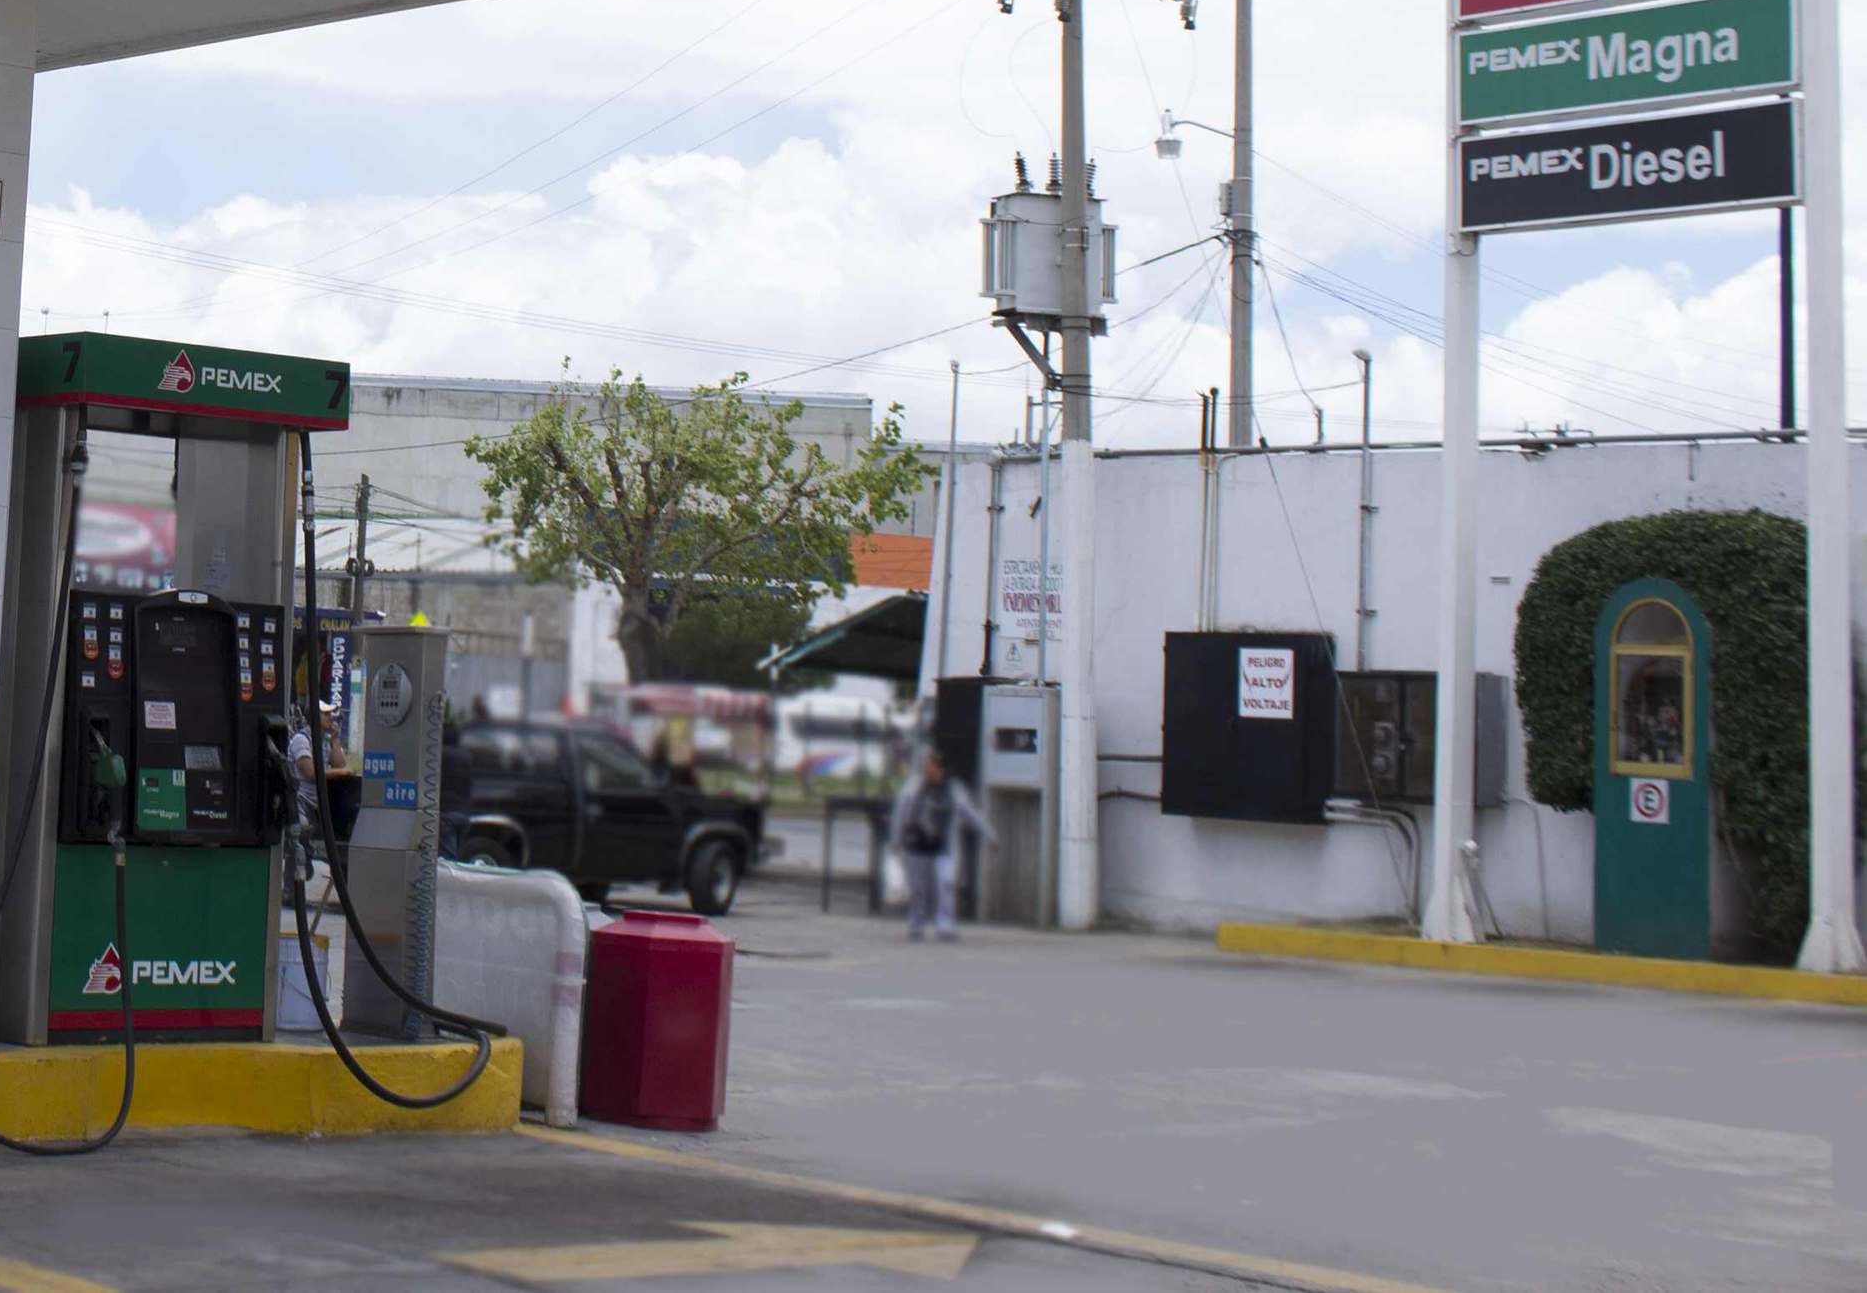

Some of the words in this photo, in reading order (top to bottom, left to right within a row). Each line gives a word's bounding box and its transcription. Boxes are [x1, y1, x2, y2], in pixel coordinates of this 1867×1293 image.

[1468, 38, 1581, 75] PEMEX
[1587, 27, 1739, 82] Magna
[1469, 147, 1584, 183] PEMEX
[1589, 130, 1726, 190] Diesel
[62, 342, 82, 383] 7
[201, 367, 282, 394] PEMEX
[325, 370, 347, 410] 7
[1248, 657, 1286, 669] PELIGRO
[1252, 678, 1283, 689] ALTO
[1243, 698, 1290, 711] VOLTAJE
[364, 758, 395, 774] agua
[386, 783, 416, 801] aire
[132, 960, 237, 985] PEMEX
